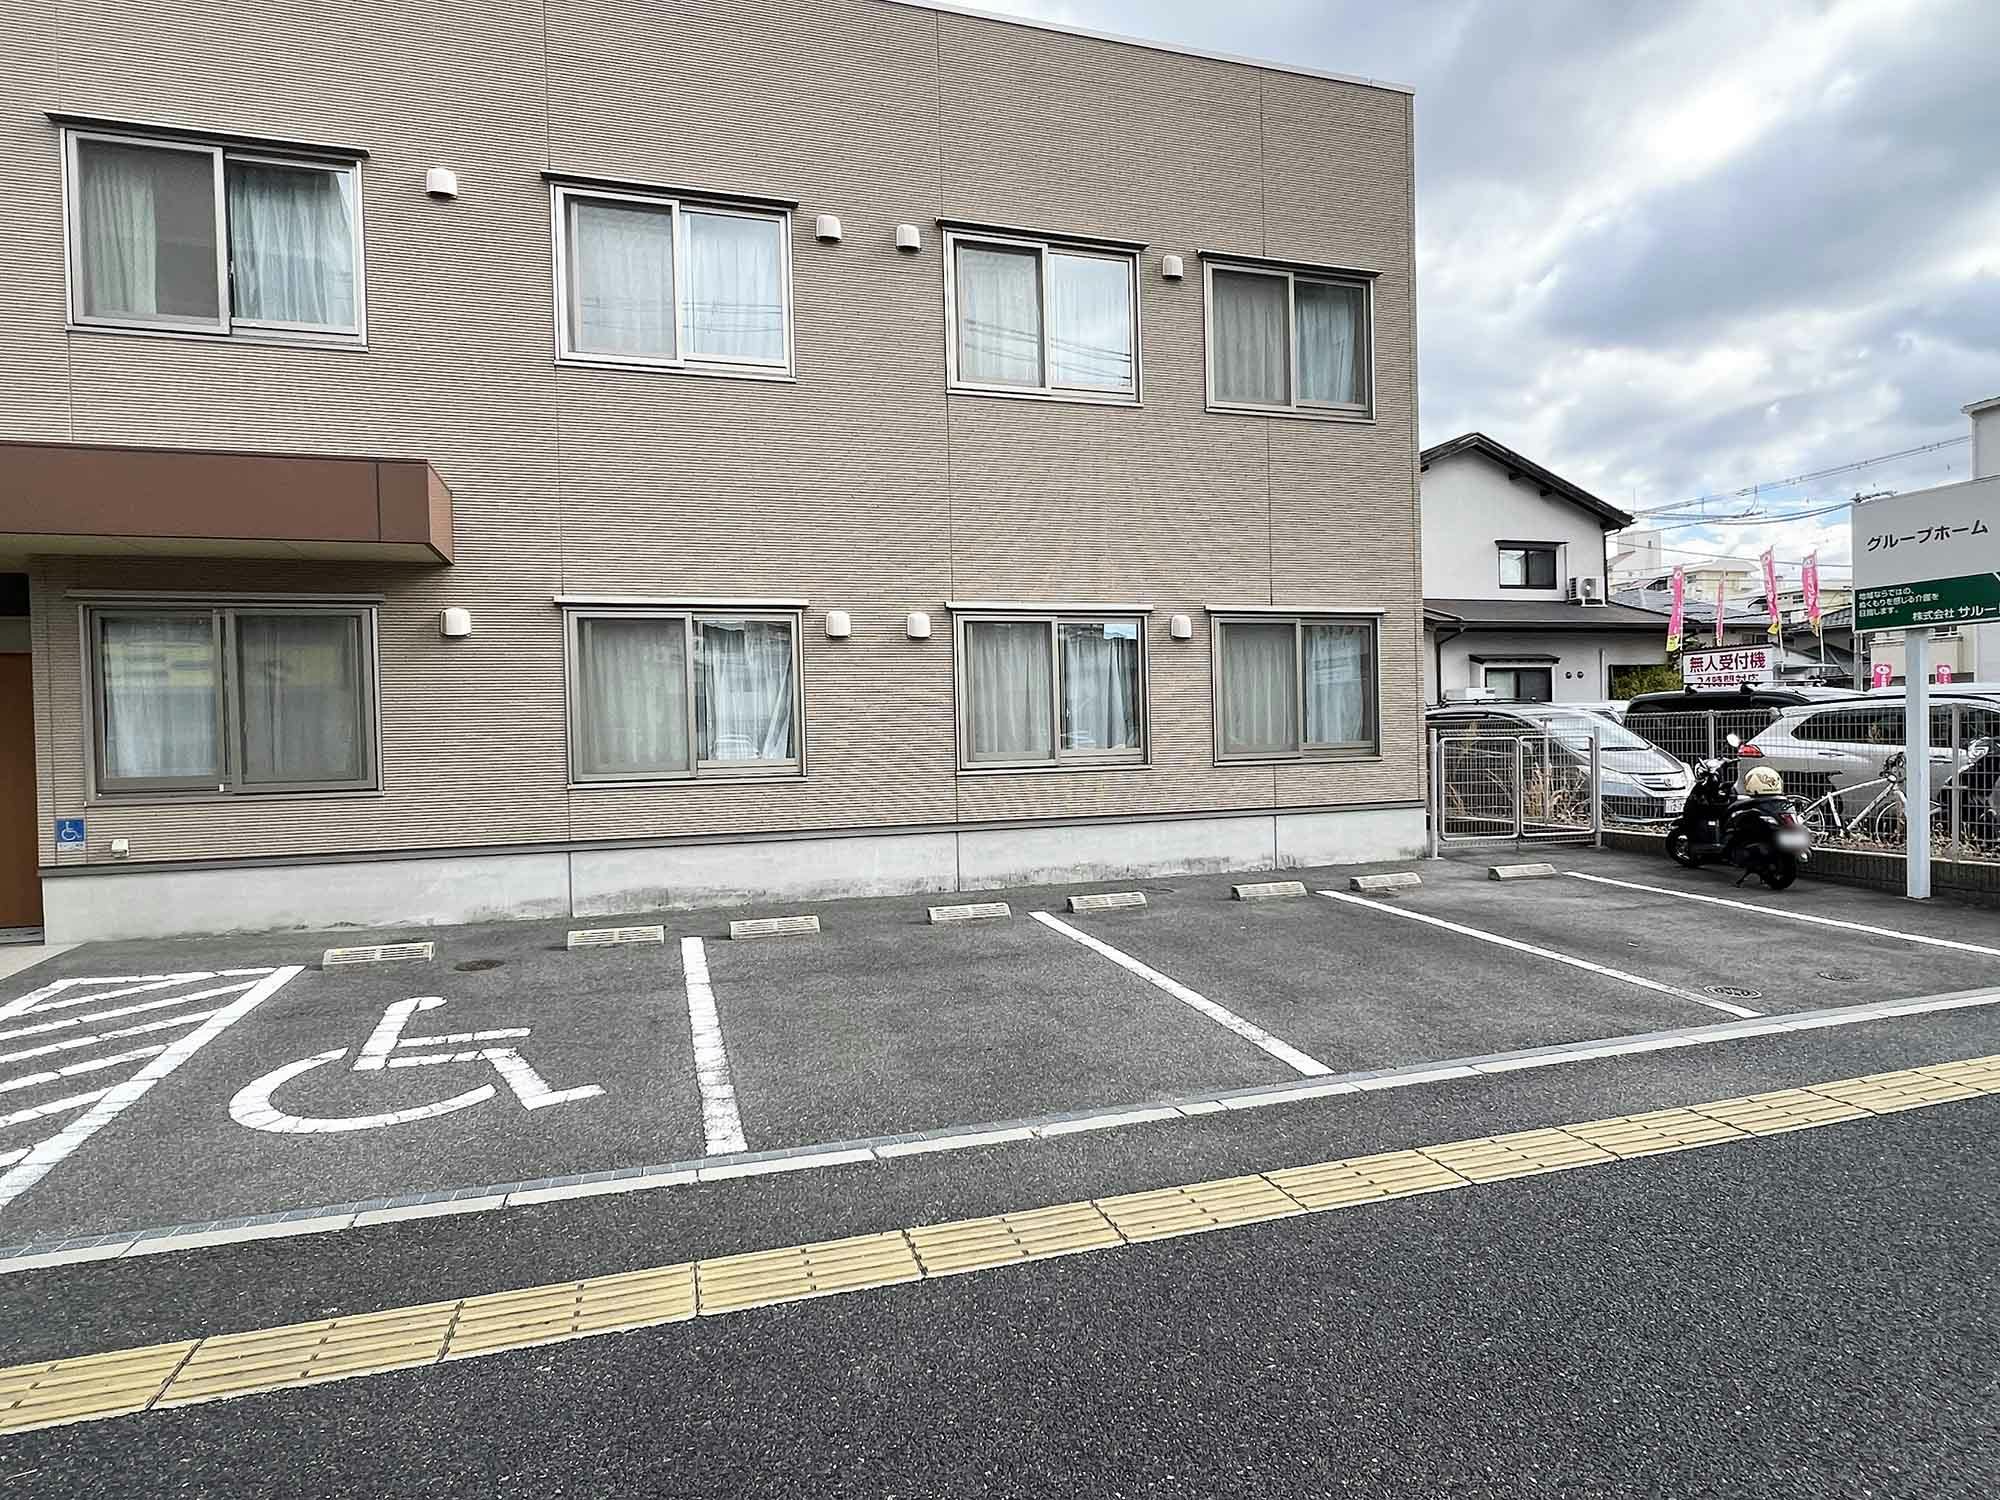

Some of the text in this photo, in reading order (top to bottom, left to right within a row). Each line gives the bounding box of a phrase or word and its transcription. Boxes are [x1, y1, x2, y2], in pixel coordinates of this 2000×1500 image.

[1867, 520, 1988, 551] グループホーム
[1912, 603, 2000, 621] 株式会社 サルー
[1690, 651, 1766, 673] 無人受付機
